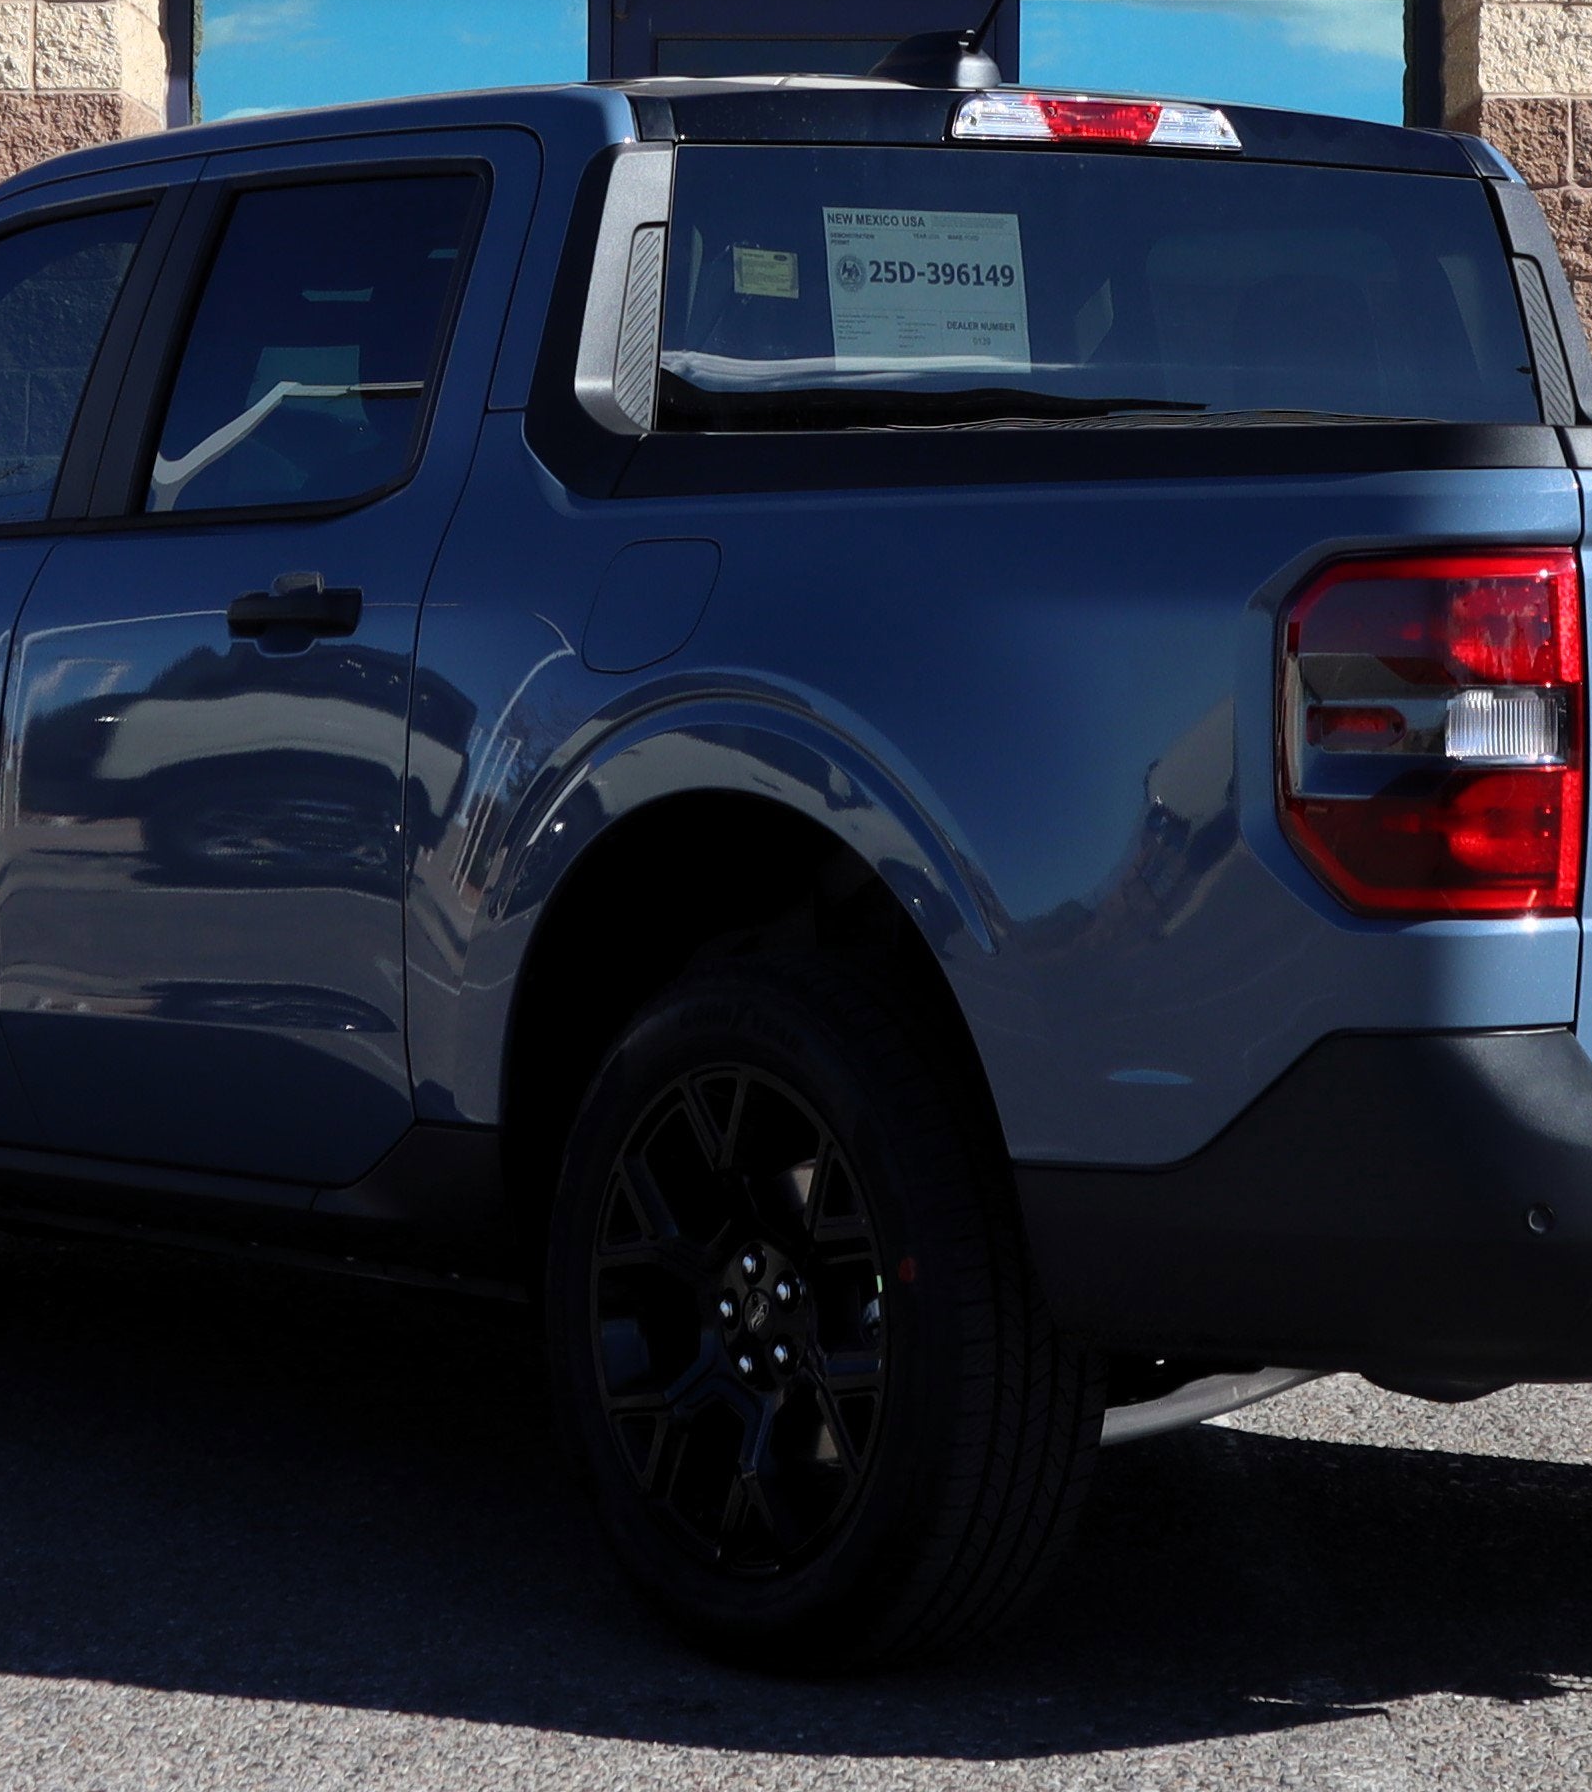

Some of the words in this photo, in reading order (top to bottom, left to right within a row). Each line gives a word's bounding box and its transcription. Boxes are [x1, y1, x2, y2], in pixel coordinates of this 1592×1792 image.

[827, 213, 854, 225] NEW
[856, 214, 899, 226] MEXICO
[902, 216, 926, 228] USA
[869, 260, 1015, 287] 25D-396149
[947, 321, 978, 331] DEALER
[980, 322, 1016, 332] NUMBER
